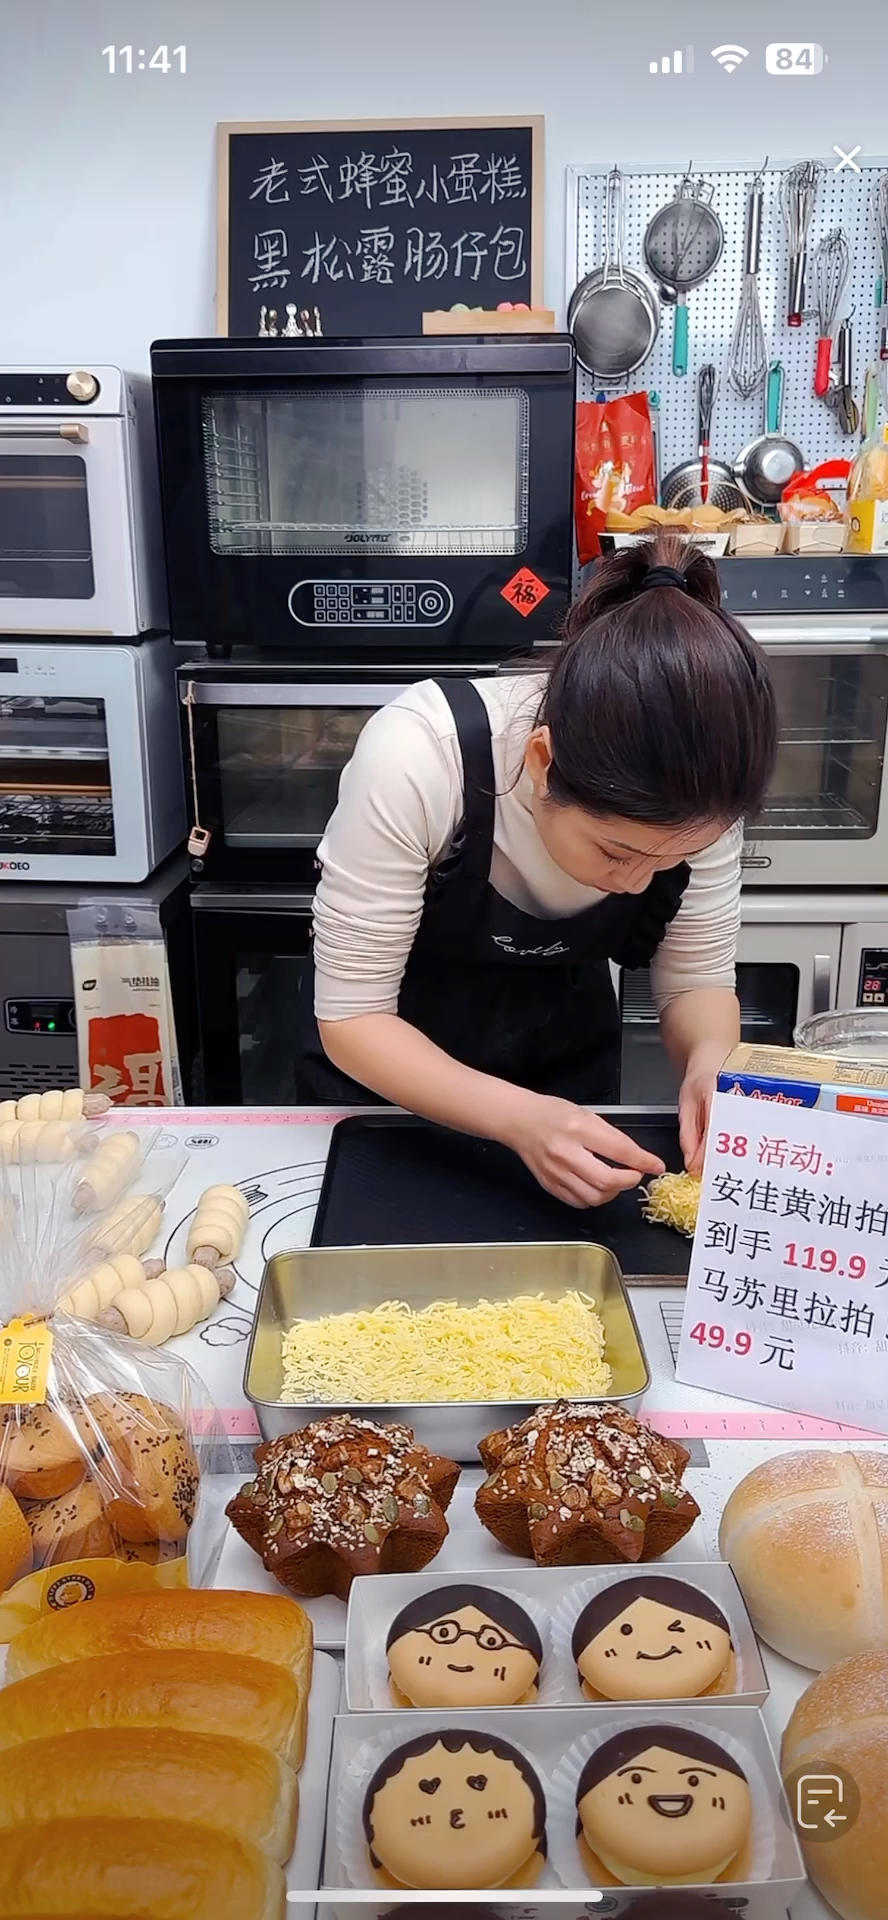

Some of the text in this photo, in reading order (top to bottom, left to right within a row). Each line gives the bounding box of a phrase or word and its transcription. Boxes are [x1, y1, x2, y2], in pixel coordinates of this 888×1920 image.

[249, 145, 527, 209] 老式蜂蜜小蛋糕
[248, 222, 527, 292] 黑松露肠仔包
[510, 578, 539, 605] 福
[715, 1132, 748, 1158] 38
[710, 1171, 888, 1236] 安佳黄油拍
[703, 1219, 773, 1260] 到手
[783, 1243, 867, 1280] 119.9
[698, 1266, 876, 1339] 马苏里拉拍
[689, 1321, 796, 1371] 49.9 元
